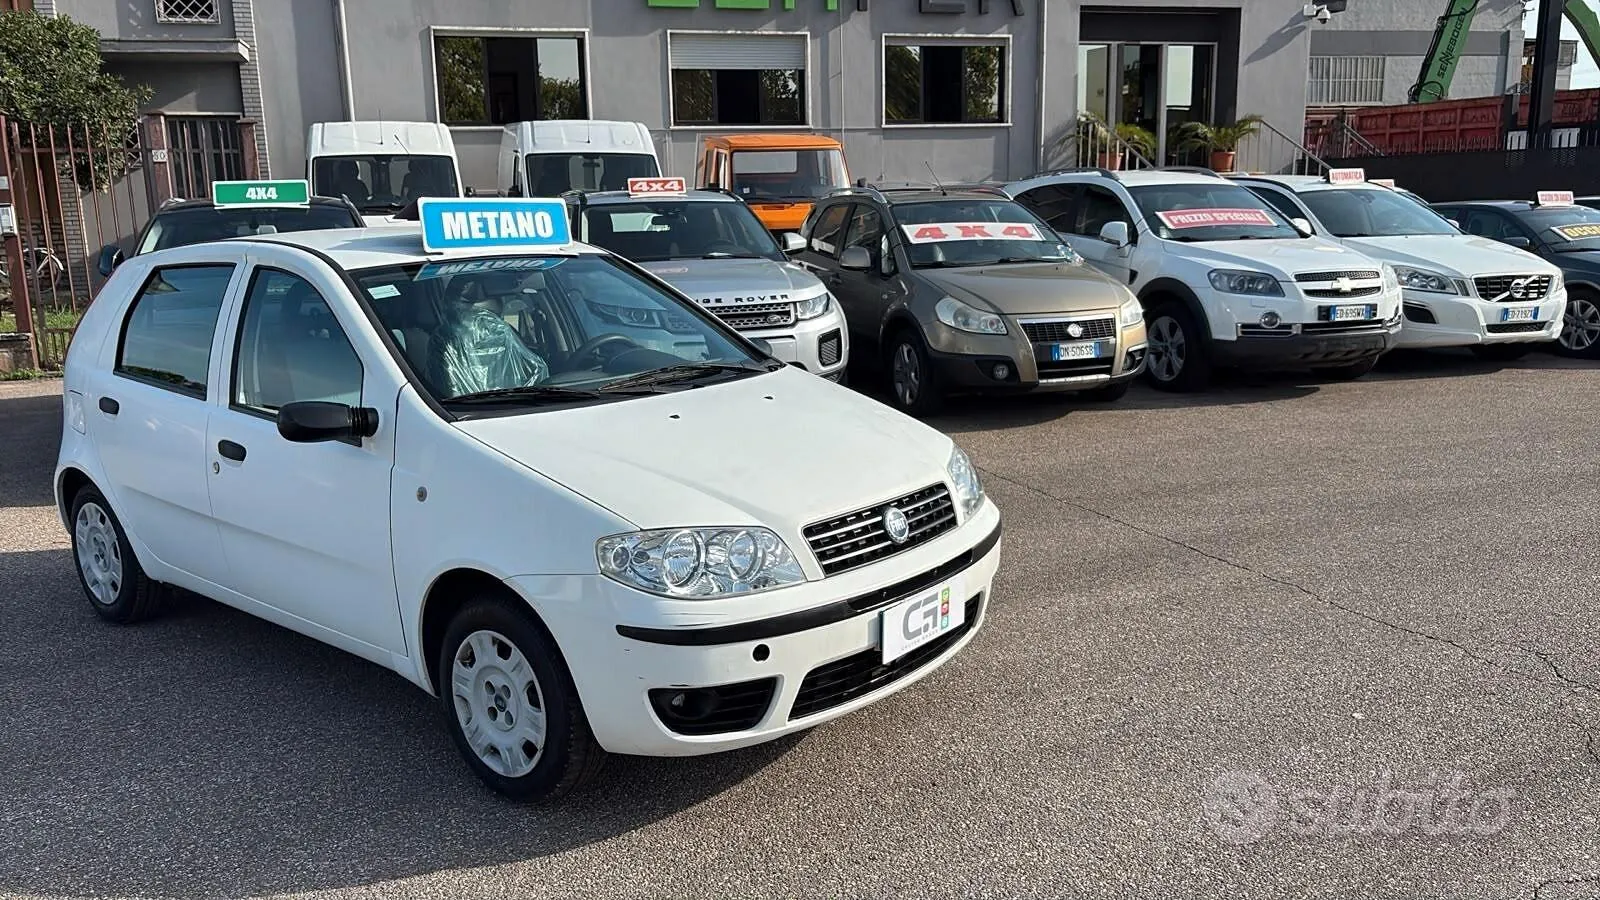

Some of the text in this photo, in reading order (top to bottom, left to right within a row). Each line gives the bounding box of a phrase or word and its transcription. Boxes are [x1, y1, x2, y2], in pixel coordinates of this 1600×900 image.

[1331, 170, 1363, 180] AUTOMATICA
[245, 186, 278, 200] 4X4
[1168, 210, 1266, 224] PREZZO SPECIALE
[441, 211, 554, 241] METANO
[735, 294, 789, 303] ROVER
